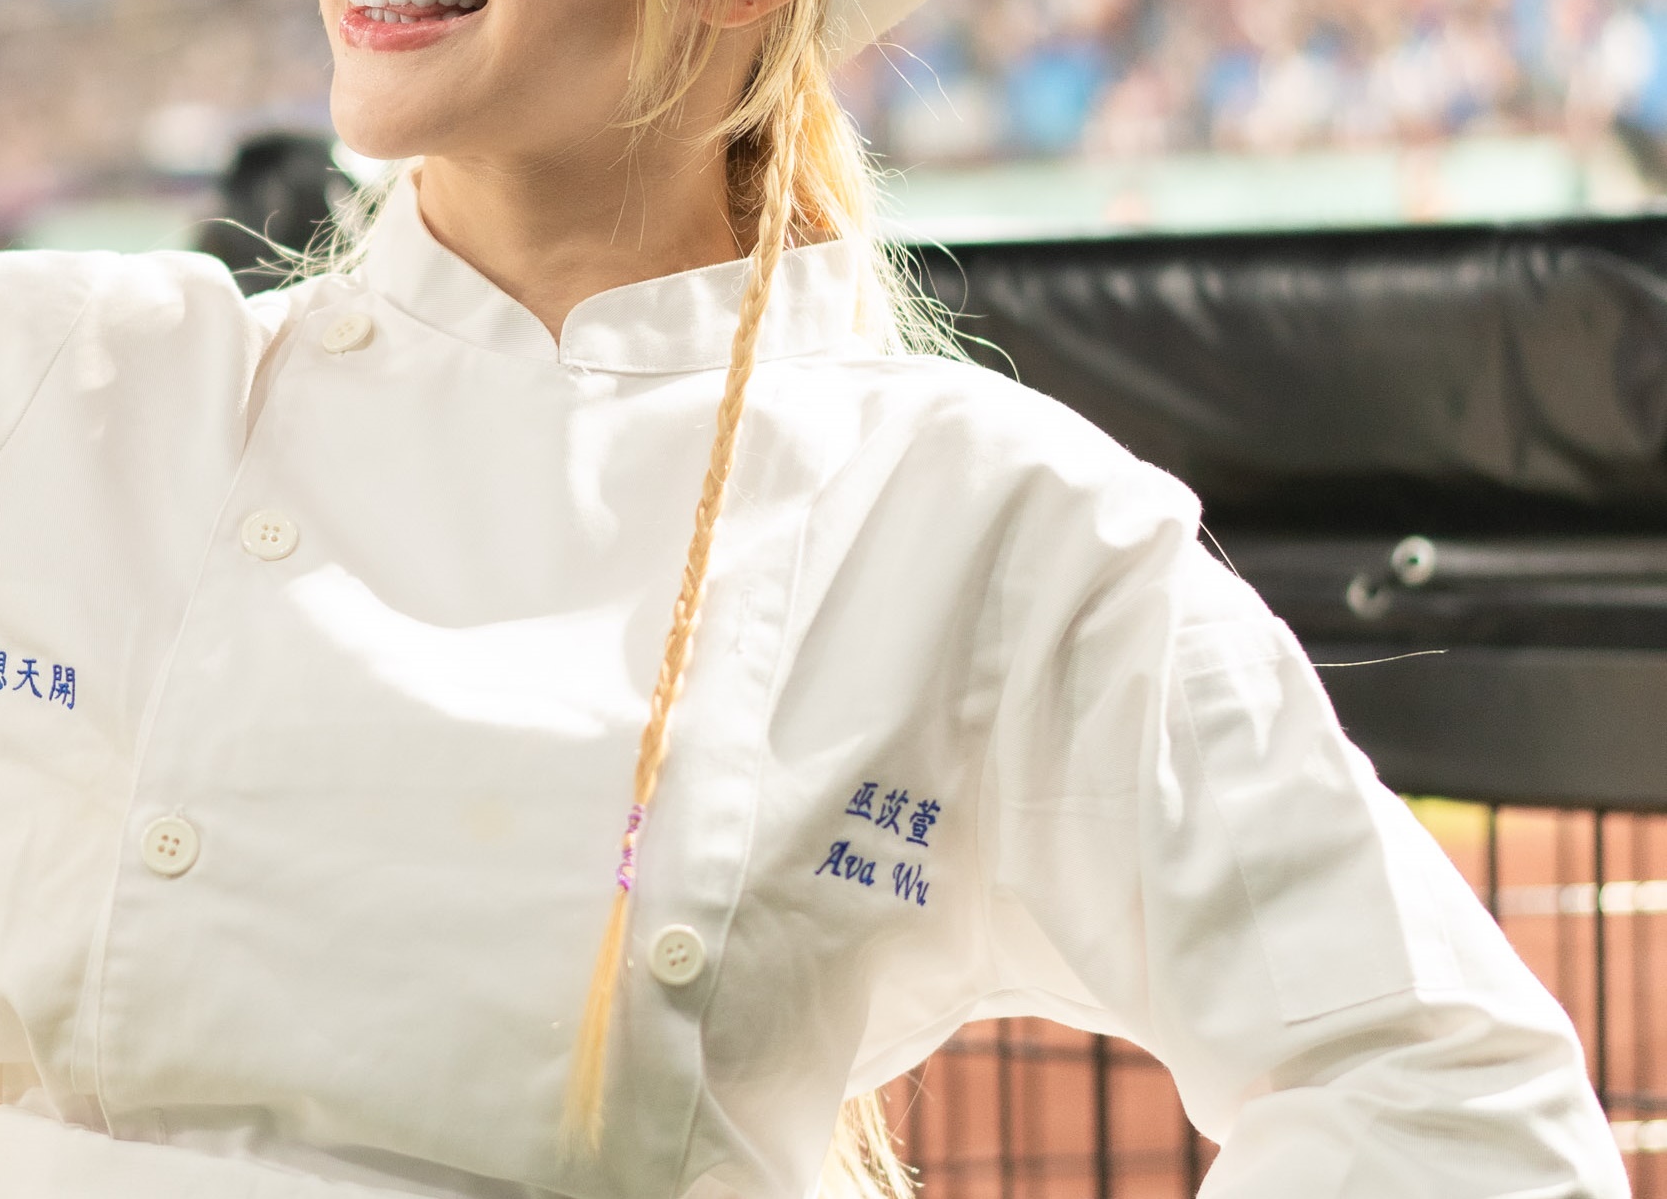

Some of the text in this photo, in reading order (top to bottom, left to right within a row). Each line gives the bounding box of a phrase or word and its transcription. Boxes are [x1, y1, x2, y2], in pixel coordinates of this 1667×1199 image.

[844, 782, 942, 848] 巫苡萱
[813, 840, 930, 907] Ava Wu
